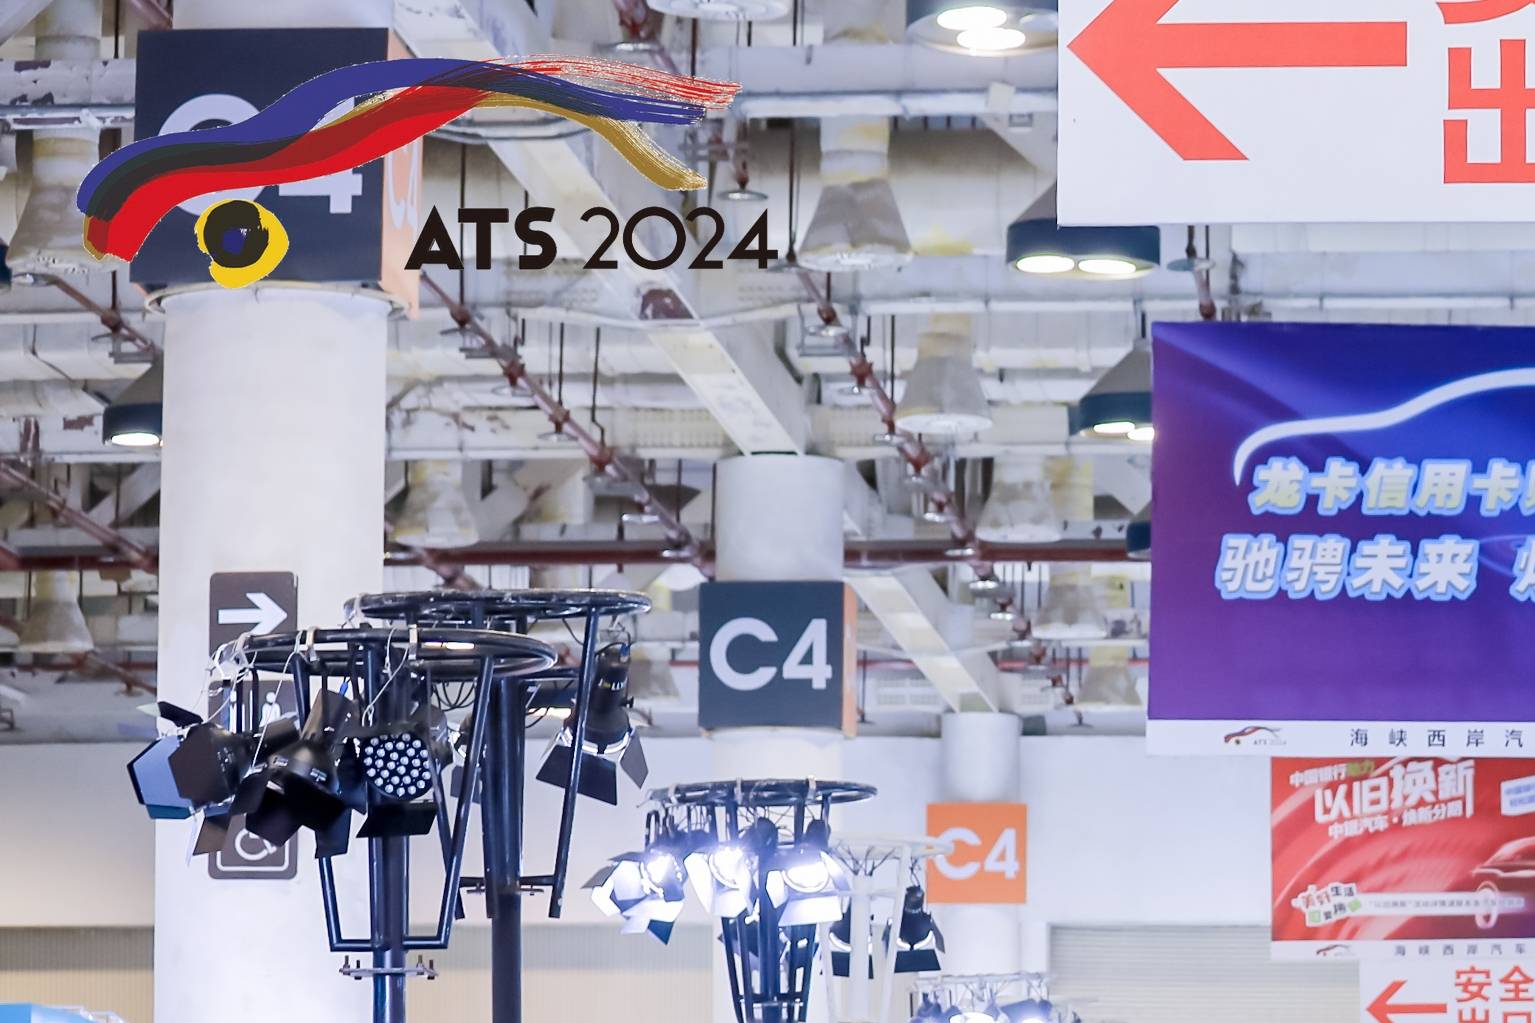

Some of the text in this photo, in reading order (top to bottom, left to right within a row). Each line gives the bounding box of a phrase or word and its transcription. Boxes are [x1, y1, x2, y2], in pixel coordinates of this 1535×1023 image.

[1216, 534, 1480, 602] 驰骋未来
[709, 617, 832, 690] C4
[1314, 760, 1475, 823] 以旧换新
[933, 826, 1020, 880] C4
[1455, 965, 1535, 1003] 安全
